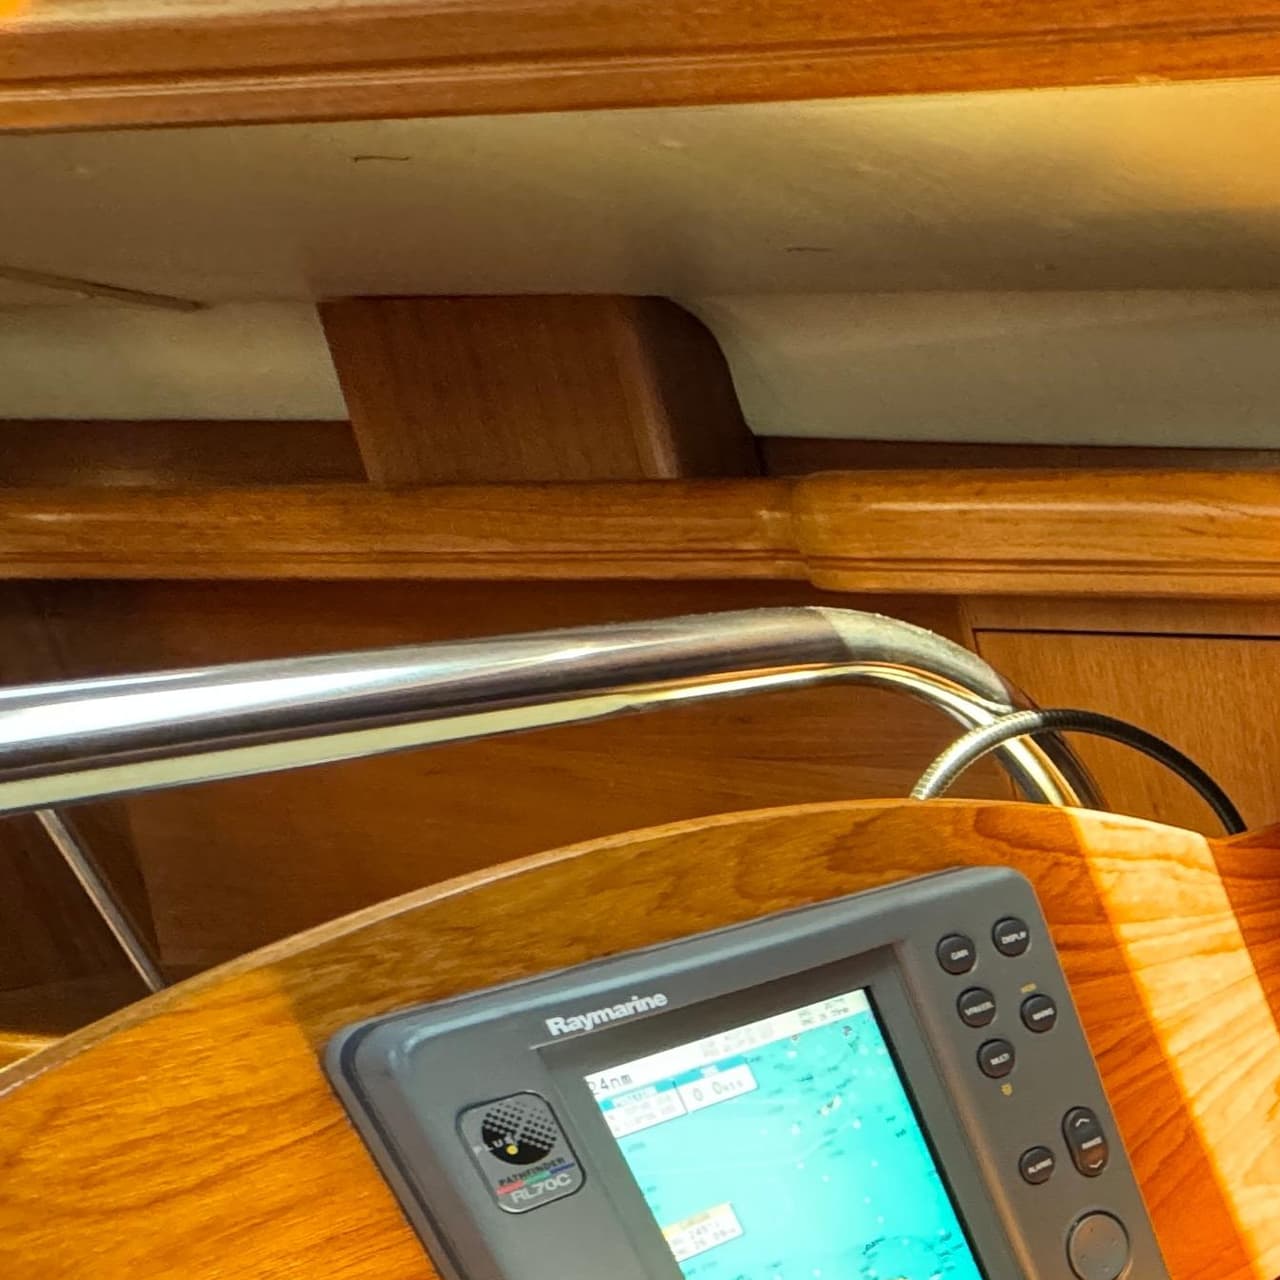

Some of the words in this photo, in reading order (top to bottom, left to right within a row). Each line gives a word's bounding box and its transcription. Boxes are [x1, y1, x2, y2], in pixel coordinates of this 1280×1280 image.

[545, 993, 668, 1036] Raymarine
[499, 1156, 565, 1186] PATHFINDER
[510, 1172, 572, 1203] RL70C
